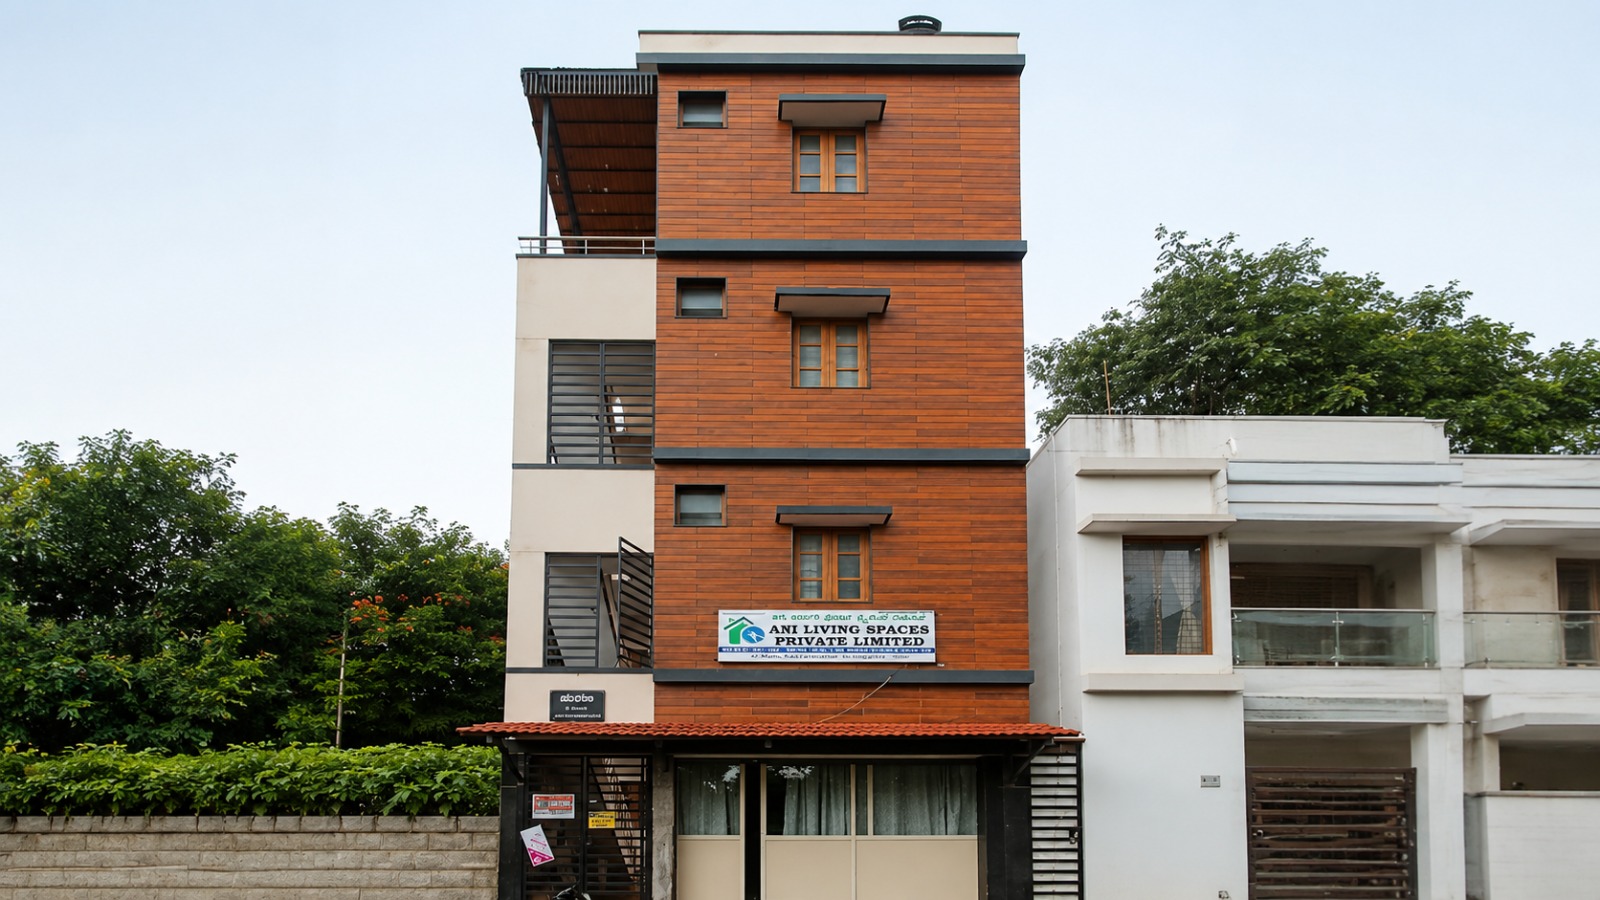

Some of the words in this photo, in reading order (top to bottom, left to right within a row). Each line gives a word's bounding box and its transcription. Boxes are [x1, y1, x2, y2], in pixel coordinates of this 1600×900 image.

[769, 625, 798, 634] ANI
[804, 625, 860, 634] LIVING
[866, 625, 930, 635] SPACES
[775, 636, 848, 646] PRIVATE
[853, 637, 925, 646] LIMITED
